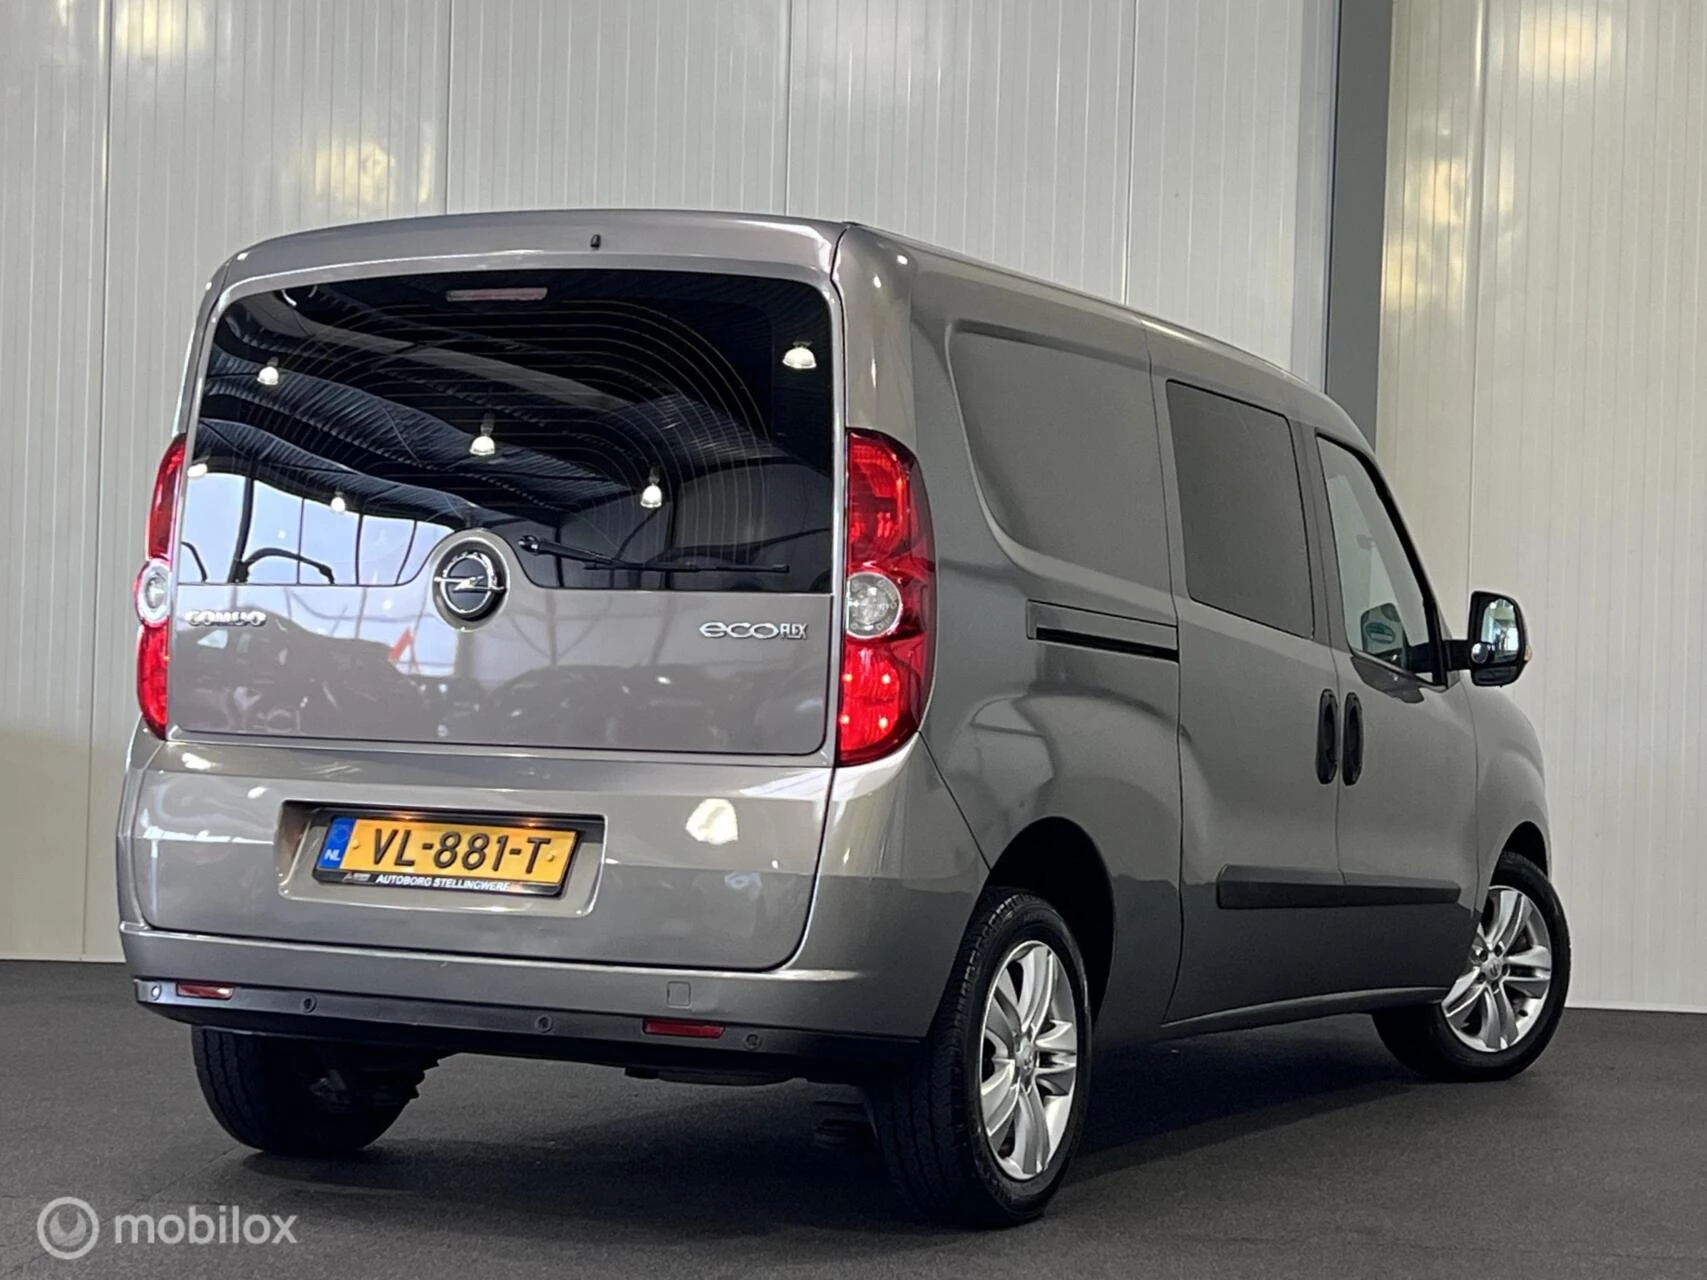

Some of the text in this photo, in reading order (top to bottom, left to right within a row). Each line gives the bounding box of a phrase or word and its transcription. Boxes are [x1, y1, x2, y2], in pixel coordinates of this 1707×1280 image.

[324, 848, 341, 861] NL
[373, 828, 551, 874] VL-881-T
[376, 874, 432, 888] AUTOBORG
